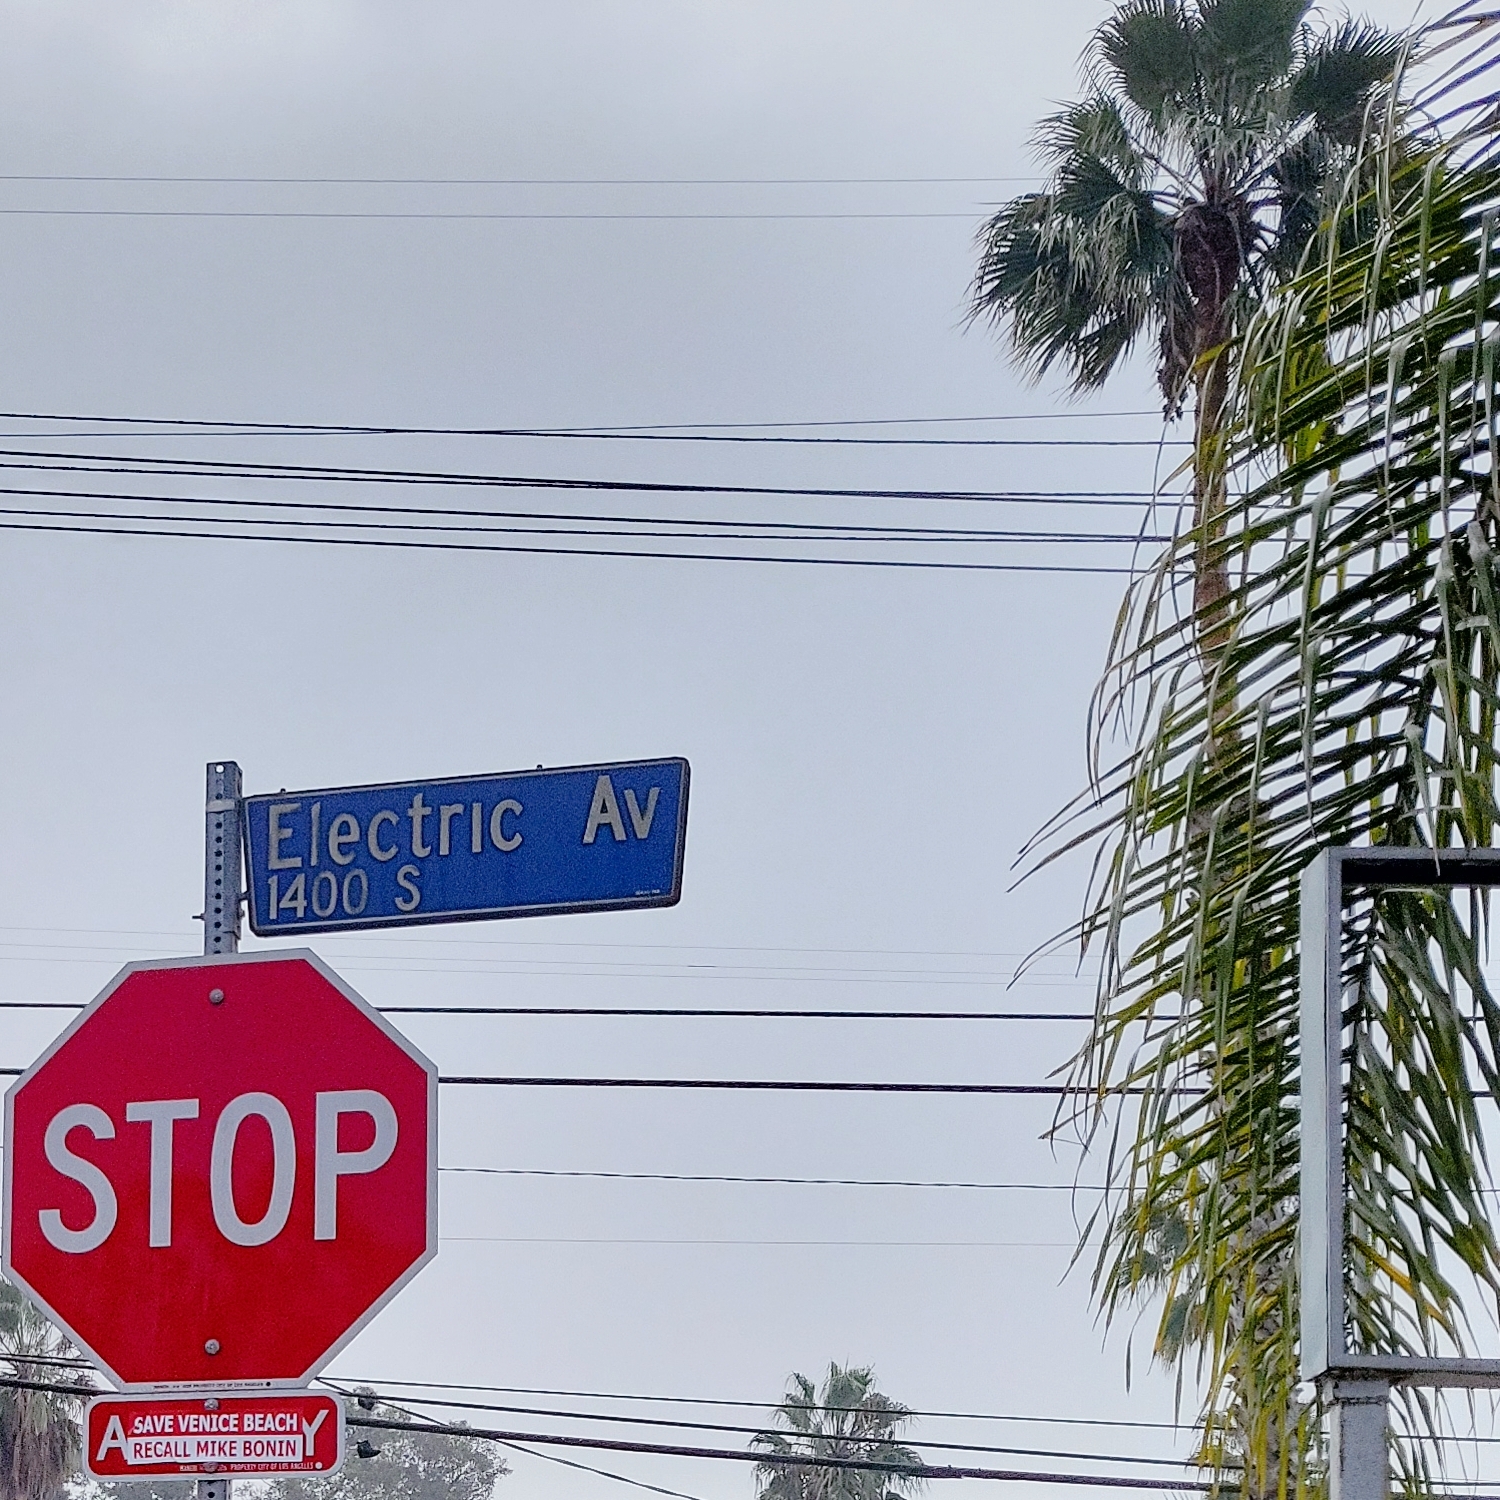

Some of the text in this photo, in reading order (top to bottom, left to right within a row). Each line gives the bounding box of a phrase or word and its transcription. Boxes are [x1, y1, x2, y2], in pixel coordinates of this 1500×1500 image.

[268, 775, 660, 870] Electric Av
[268, 864, 421, 920] 1400 S
[38, 1089, 399, 1254] STOP
[133, 1413, 297, 1434] SAVE VENICE BEACH
[134, 1439, 296, 1459] RECALL MIKE BONIN
